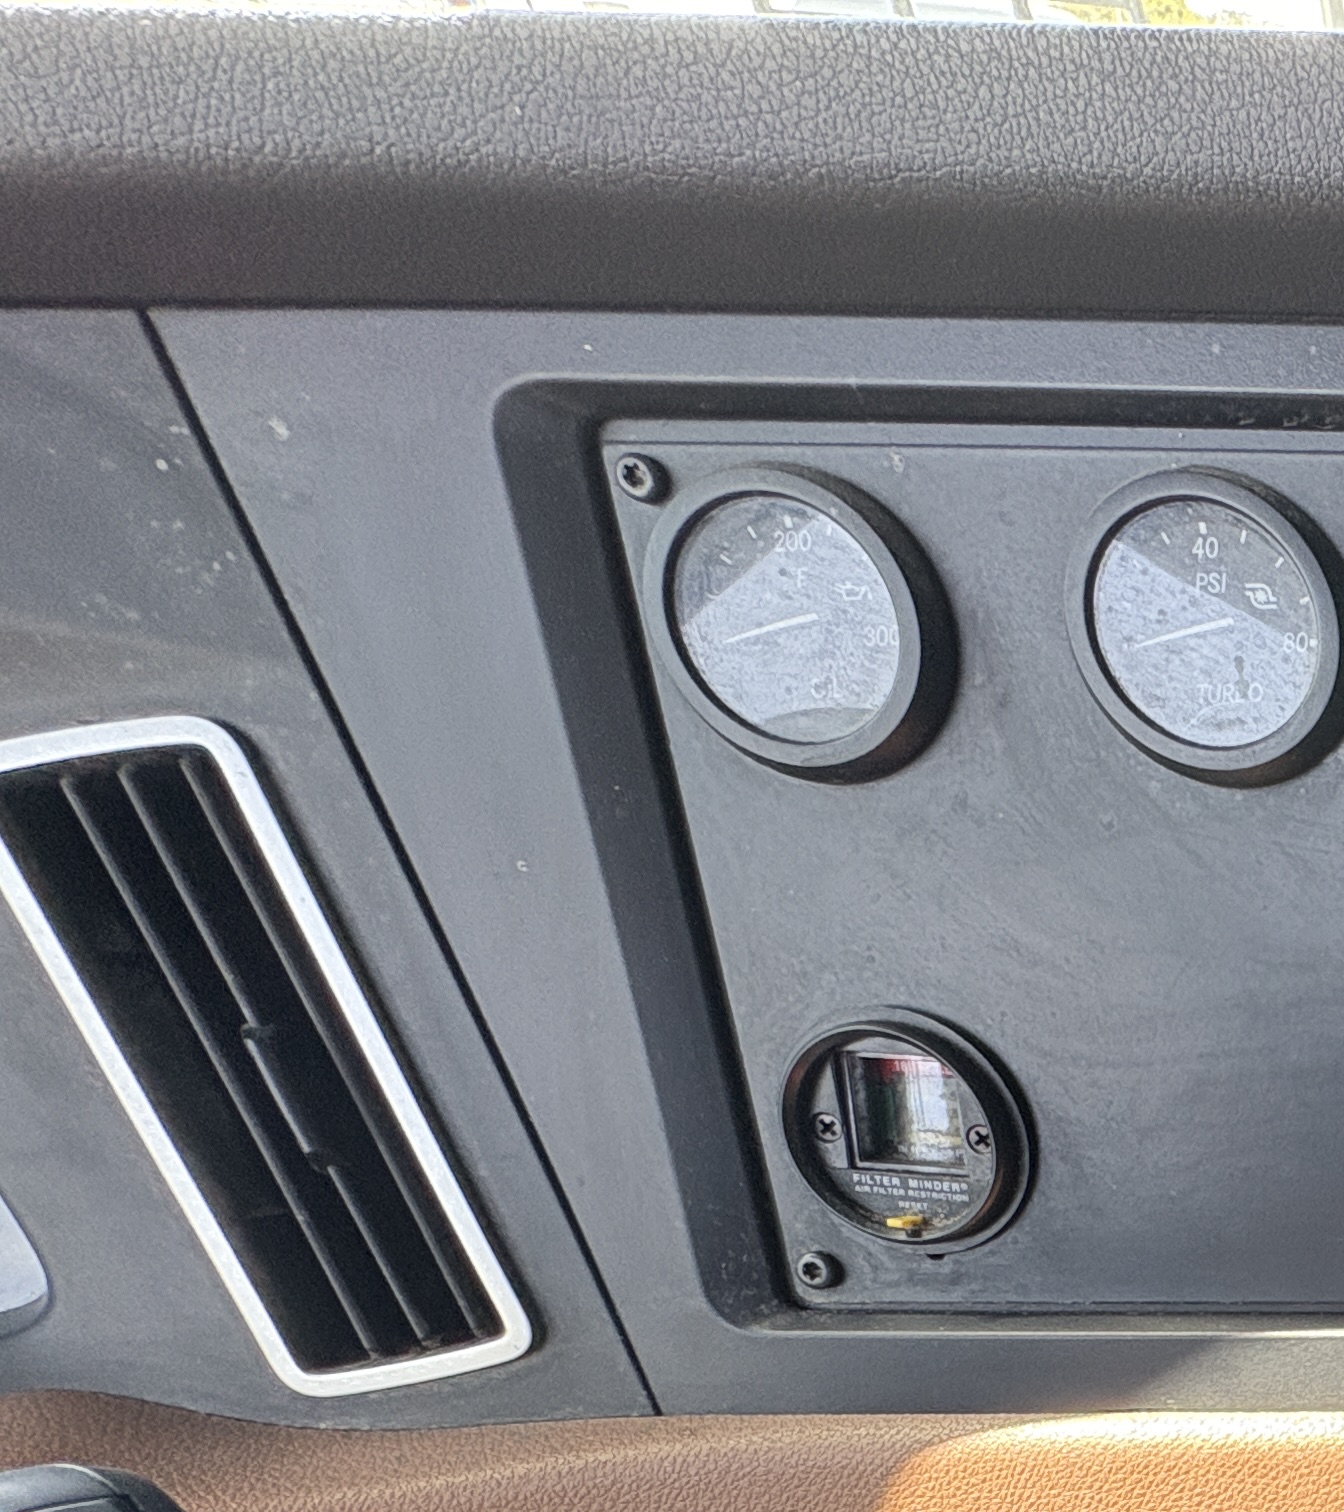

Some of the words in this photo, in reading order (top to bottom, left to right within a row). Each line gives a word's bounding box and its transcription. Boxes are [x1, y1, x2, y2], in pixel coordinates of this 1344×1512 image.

[773, 530, 812, 552] 200
[1191, 537, 1220, 560] 40
[1195, 572, 1228, 595] PSI
[865, 625, 900, 647] 300
[1282, 631, 1309, 654] 80
[853, 1173, 901, 1187] FILTER
[872, 1186, 906, 1197] FILTER
